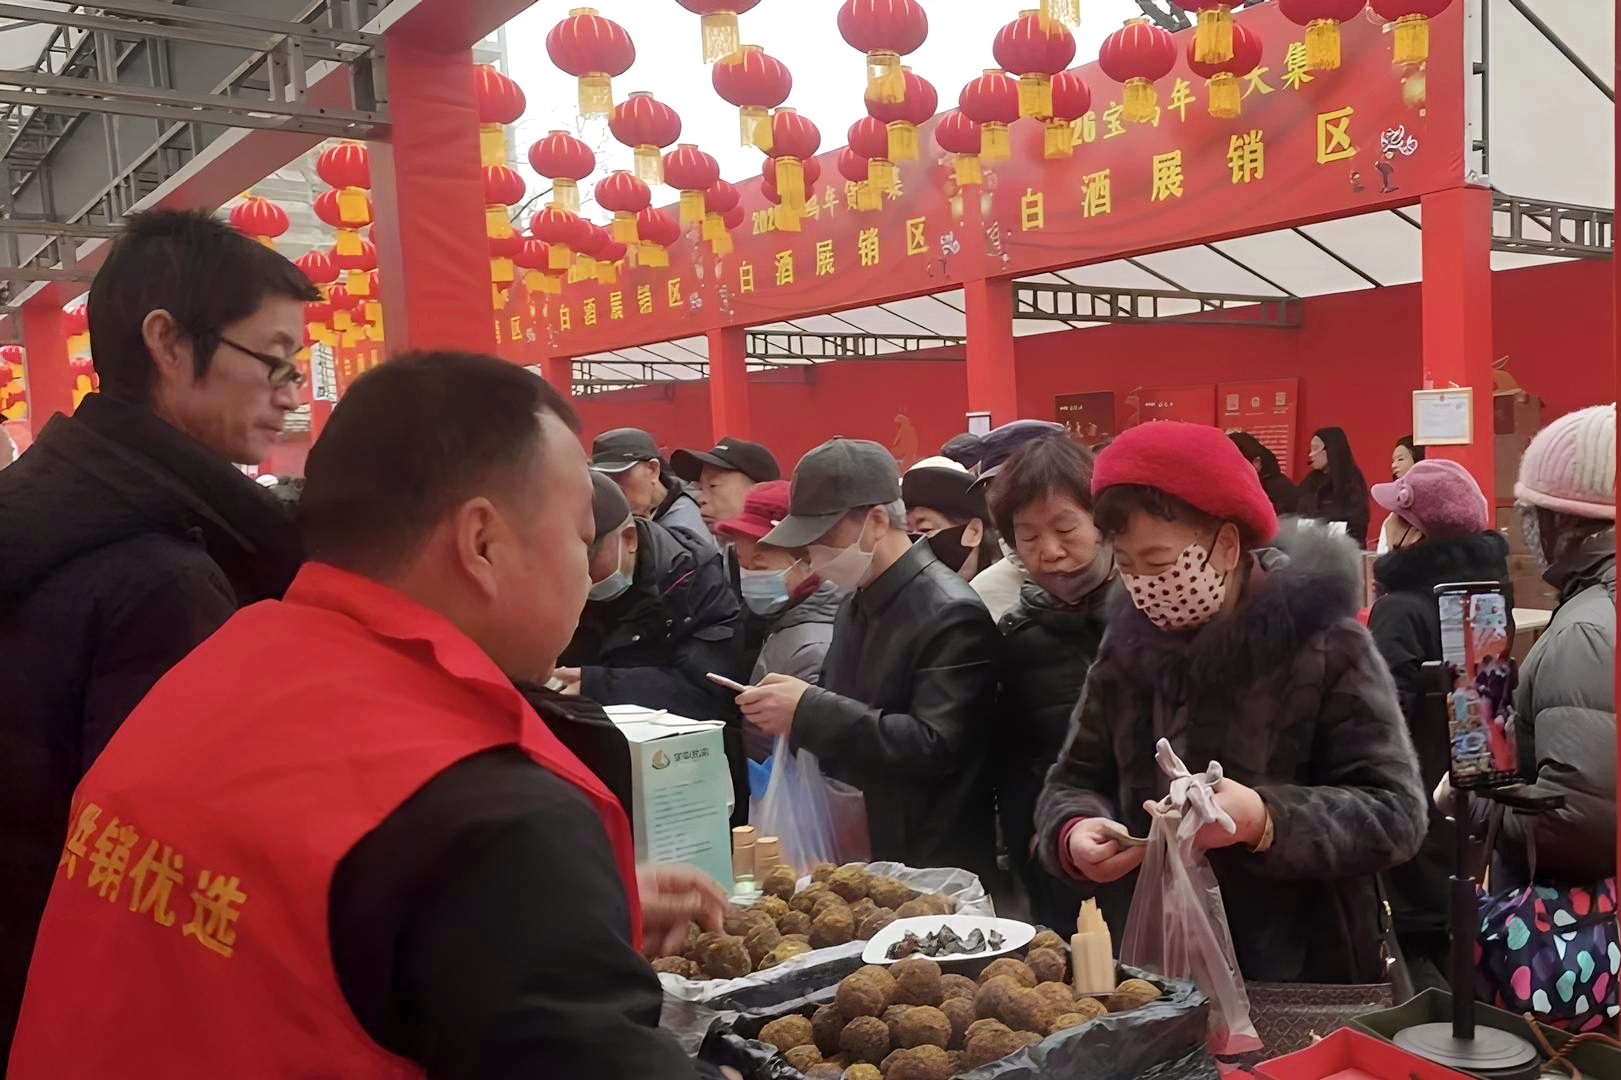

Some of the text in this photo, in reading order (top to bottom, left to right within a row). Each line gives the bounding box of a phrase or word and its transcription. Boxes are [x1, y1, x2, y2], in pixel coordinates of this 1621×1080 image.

[1020, 106, 1360, 232] 白酒展销区
[739, 216, 930, 294] 白酒展销区
